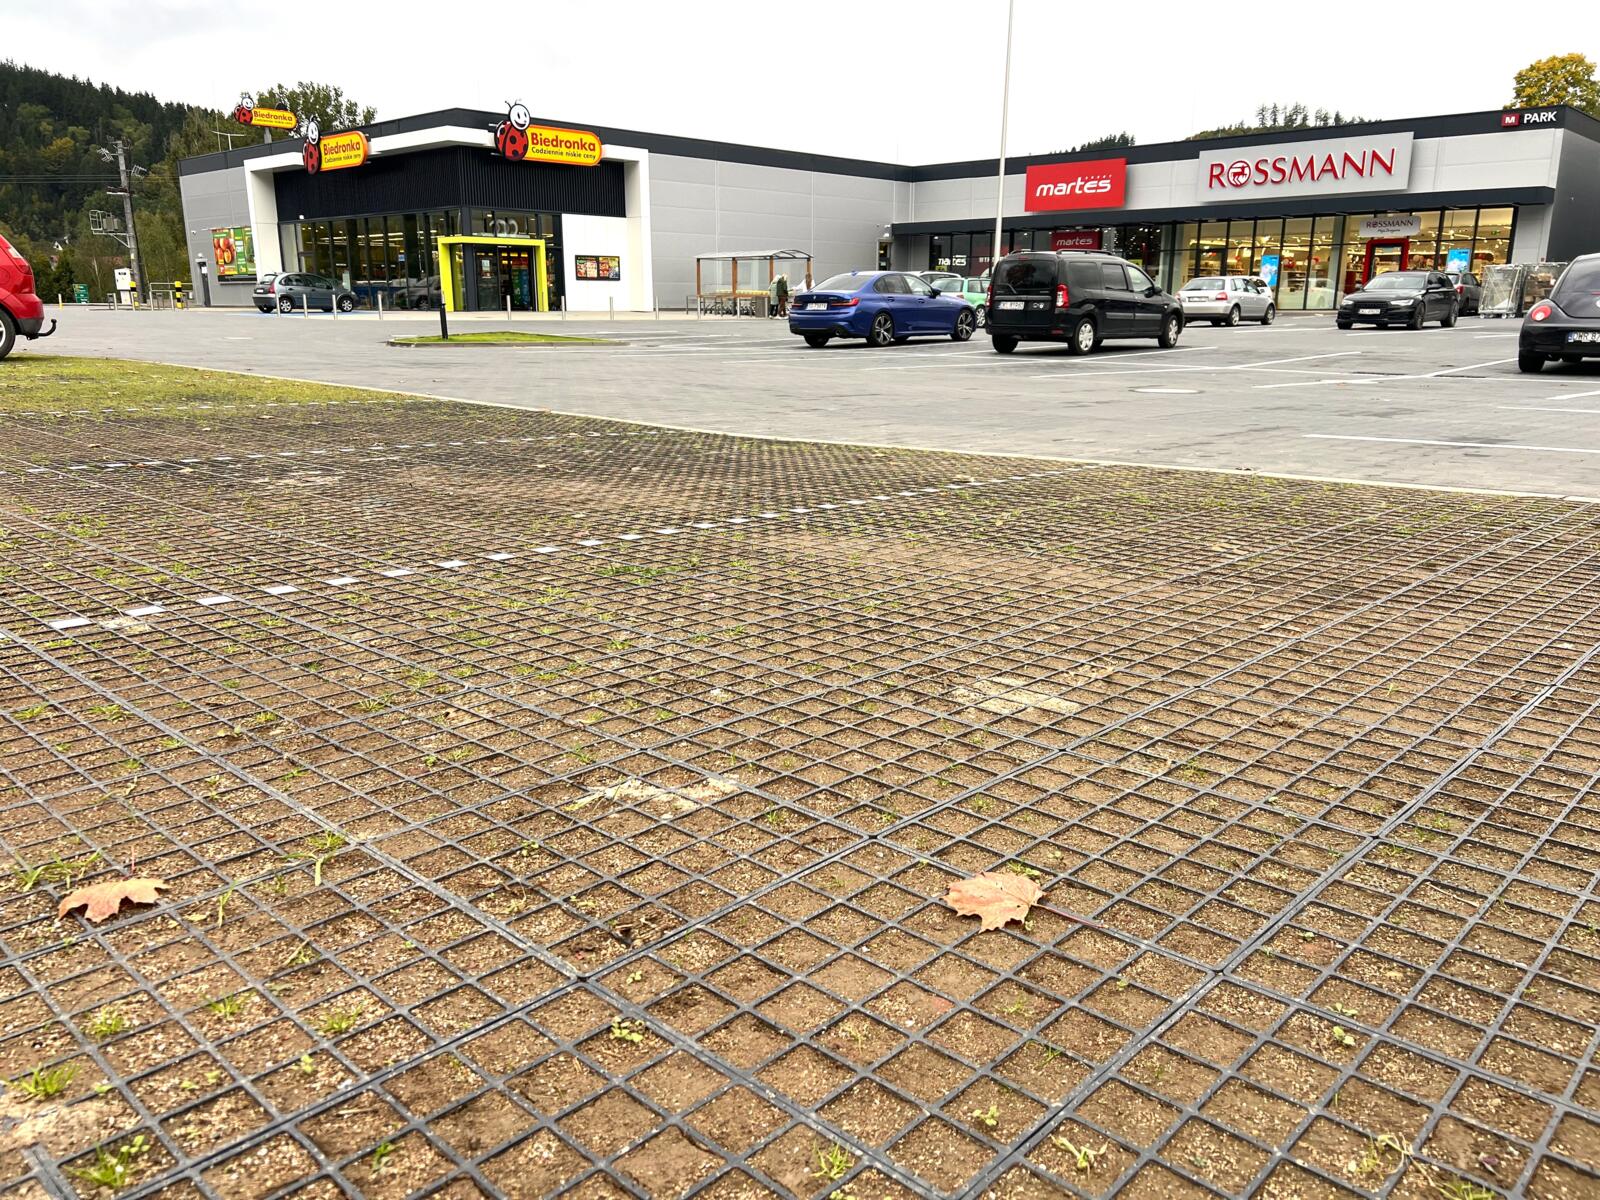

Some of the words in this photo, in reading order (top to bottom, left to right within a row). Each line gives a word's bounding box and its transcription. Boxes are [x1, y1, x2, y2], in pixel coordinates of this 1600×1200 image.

[253, 110, 293, 122] Biedronka
[1504, 116, 1517, 124] M
[1523, 110, 1558, 124] PARK
[323, 138, 361, 156] Biedronka
[531, 131, 597, 152] Biedronka
[531, 146, 564, 157] Codziennie
[565, 149, 582, 158] niskie
[583, 151, 597, 160] ceny
[1208, 148, 1396, 189] ROSSMANN
[1035, 176, 1112, 197] martes
[1366, 219, 1414, 229] ROSSMANN
[1056, 236, 1093, 246] martes
